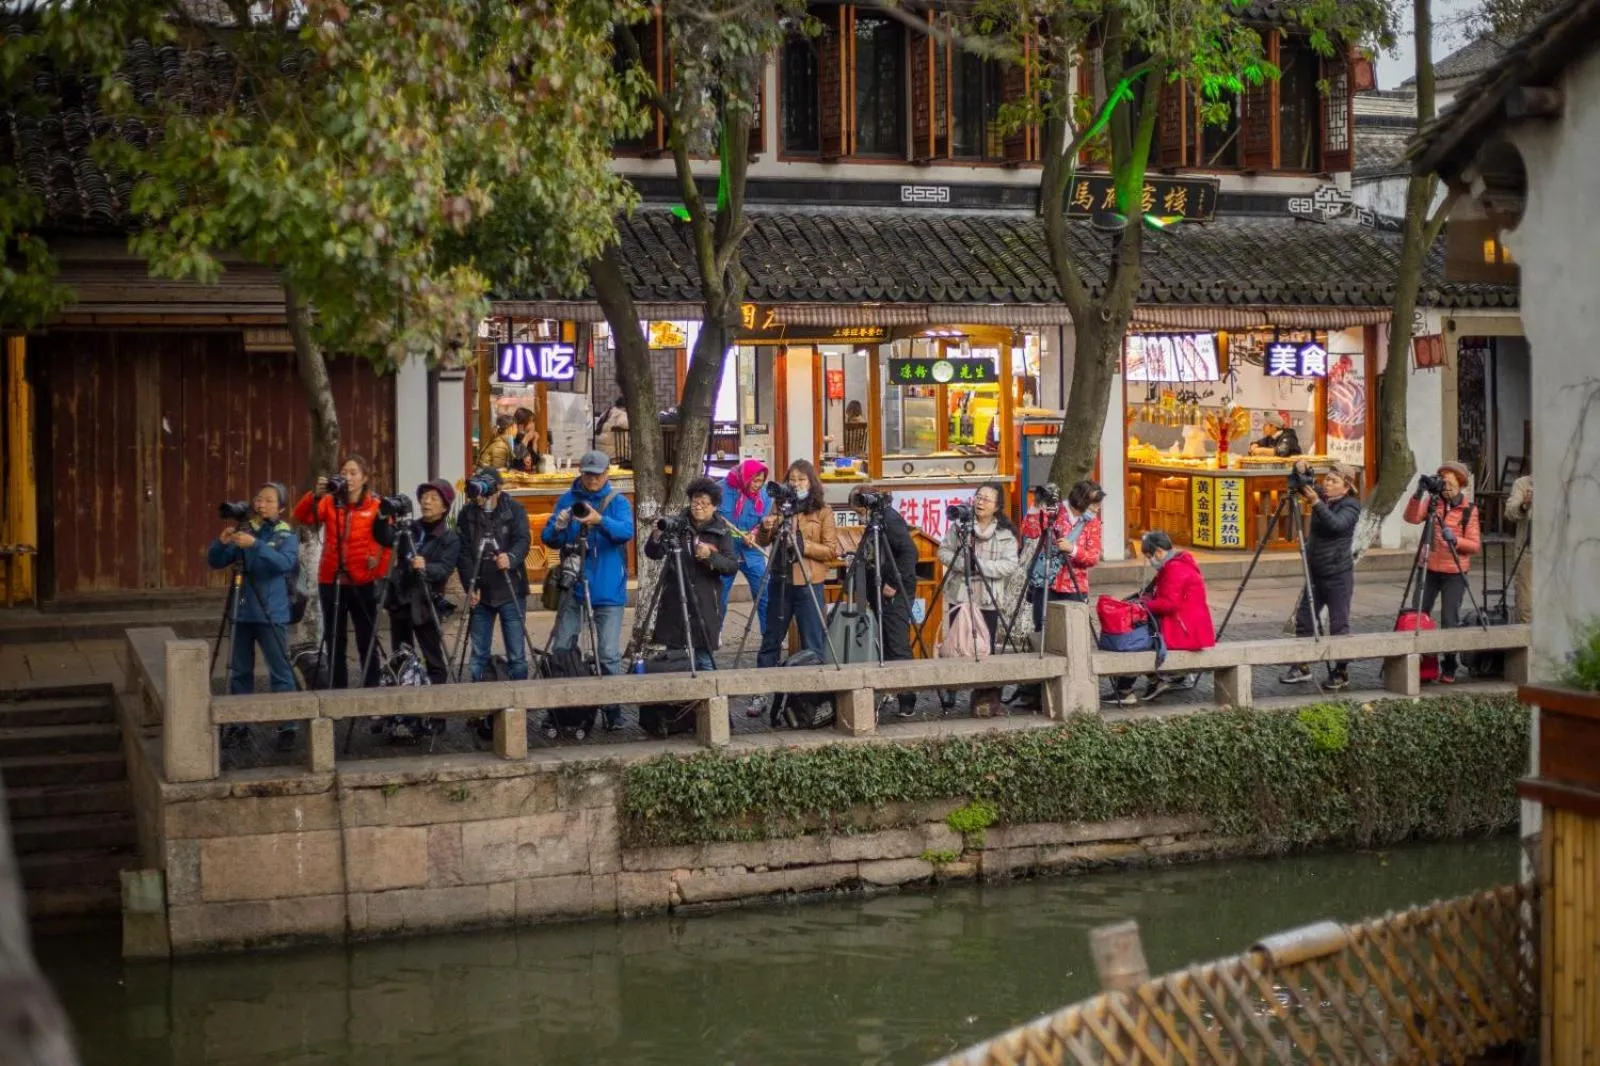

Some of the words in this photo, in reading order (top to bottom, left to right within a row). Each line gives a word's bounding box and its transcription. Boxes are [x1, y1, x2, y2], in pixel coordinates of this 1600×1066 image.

[501, 344, 574, 381] 小吃
[1269, 343, 1327, 376] 美食
[1196, 480, 1210, 542] 黄金薯塔
[1220, 479, 1240, 545] 芝士拉丝热狗
